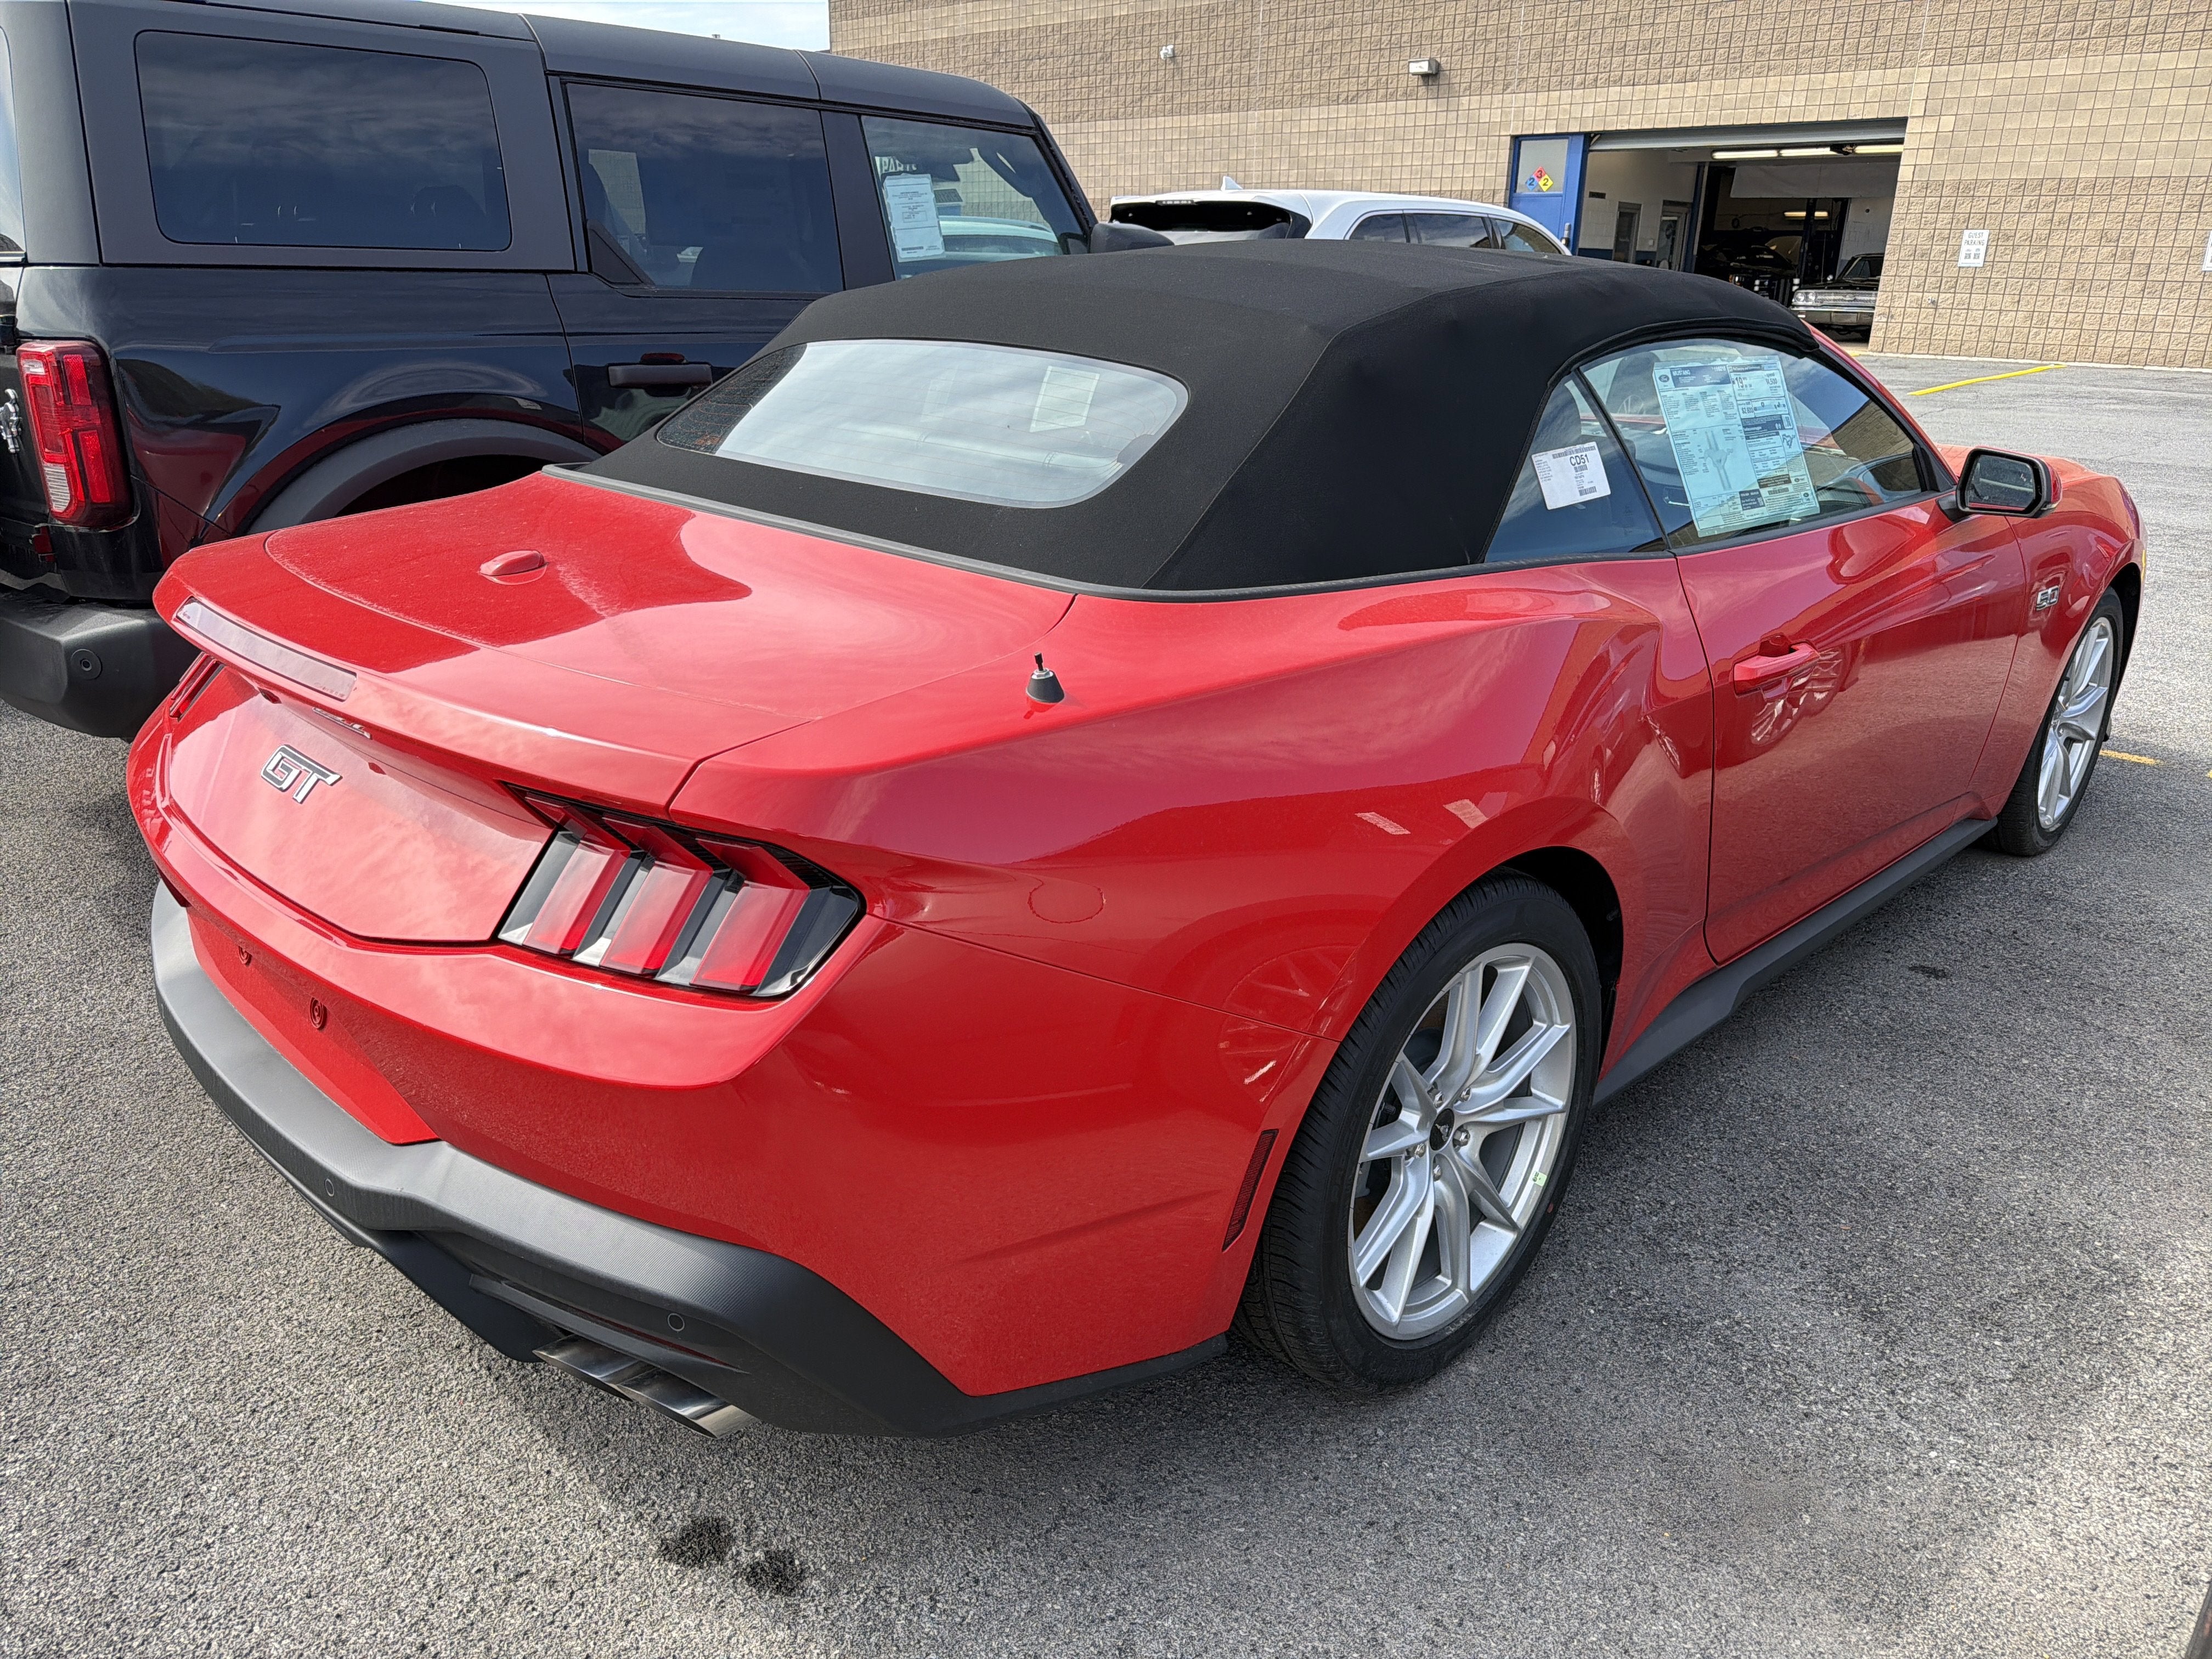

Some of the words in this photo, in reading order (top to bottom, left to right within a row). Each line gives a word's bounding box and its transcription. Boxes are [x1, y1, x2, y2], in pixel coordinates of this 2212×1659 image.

[1536, 170, 1543, 178] 3
[1528, 177, 1535, 186] 2
[1542, 178, 1549, 186] 2
[1735, 377, 1744, 388] 19
[1569, 453, 1589, 466] CD51
[261, 744, 343, 804] GT
